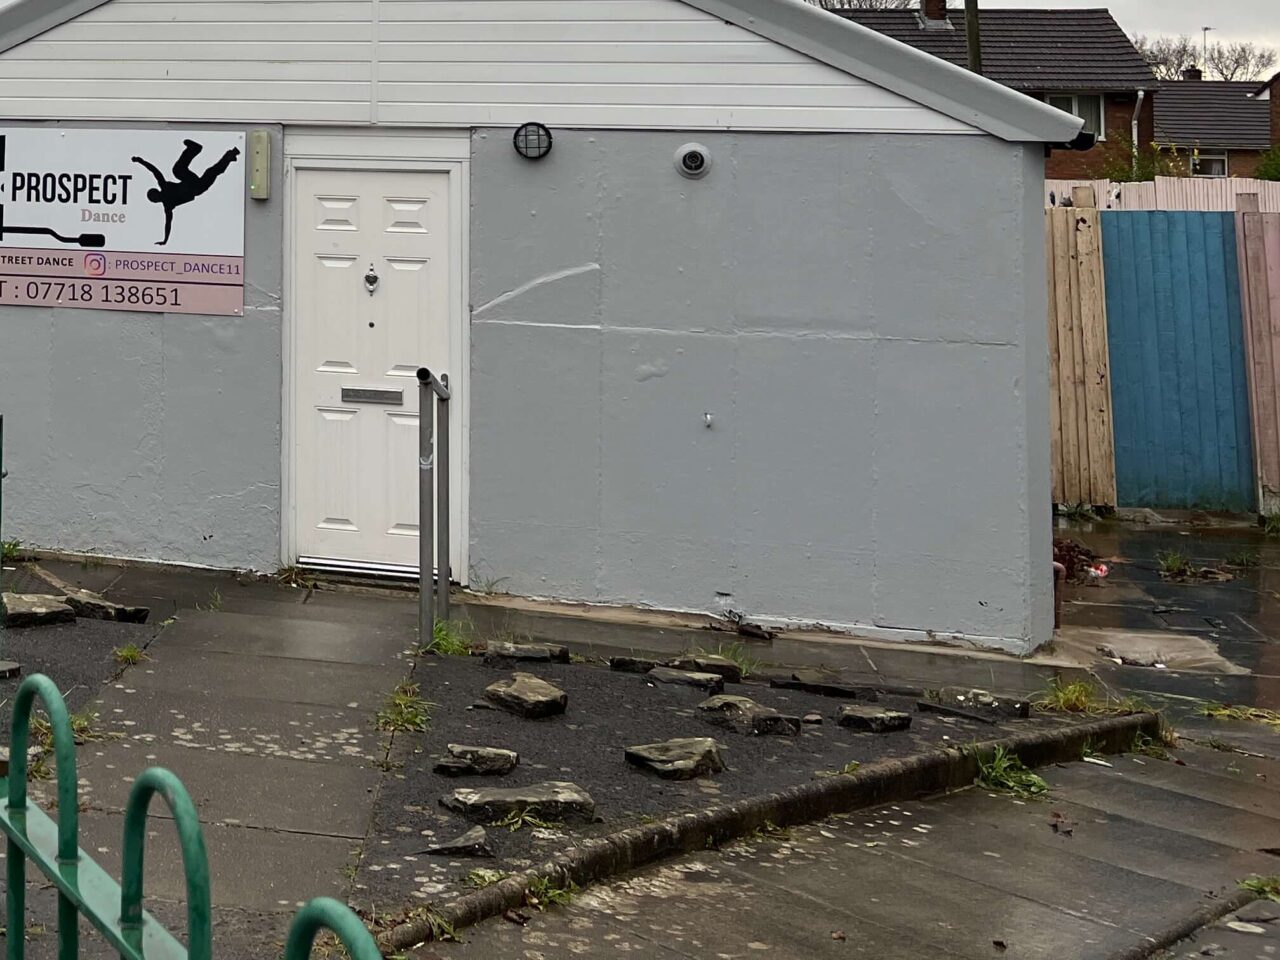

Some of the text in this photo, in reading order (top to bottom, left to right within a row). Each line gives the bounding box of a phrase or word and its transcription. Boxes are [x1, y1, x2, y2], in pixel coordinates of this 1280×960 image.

[11, 172, 133, 205] PROSPECT
[80, 208, 126, 224] Dance
[37, 257, 74, 267] DANCE
[115, 259, 240, 275] PROSPECT_DANCE11
[26, 281, 93, 302] 07718
[101, 285, 182, 307] 138651
